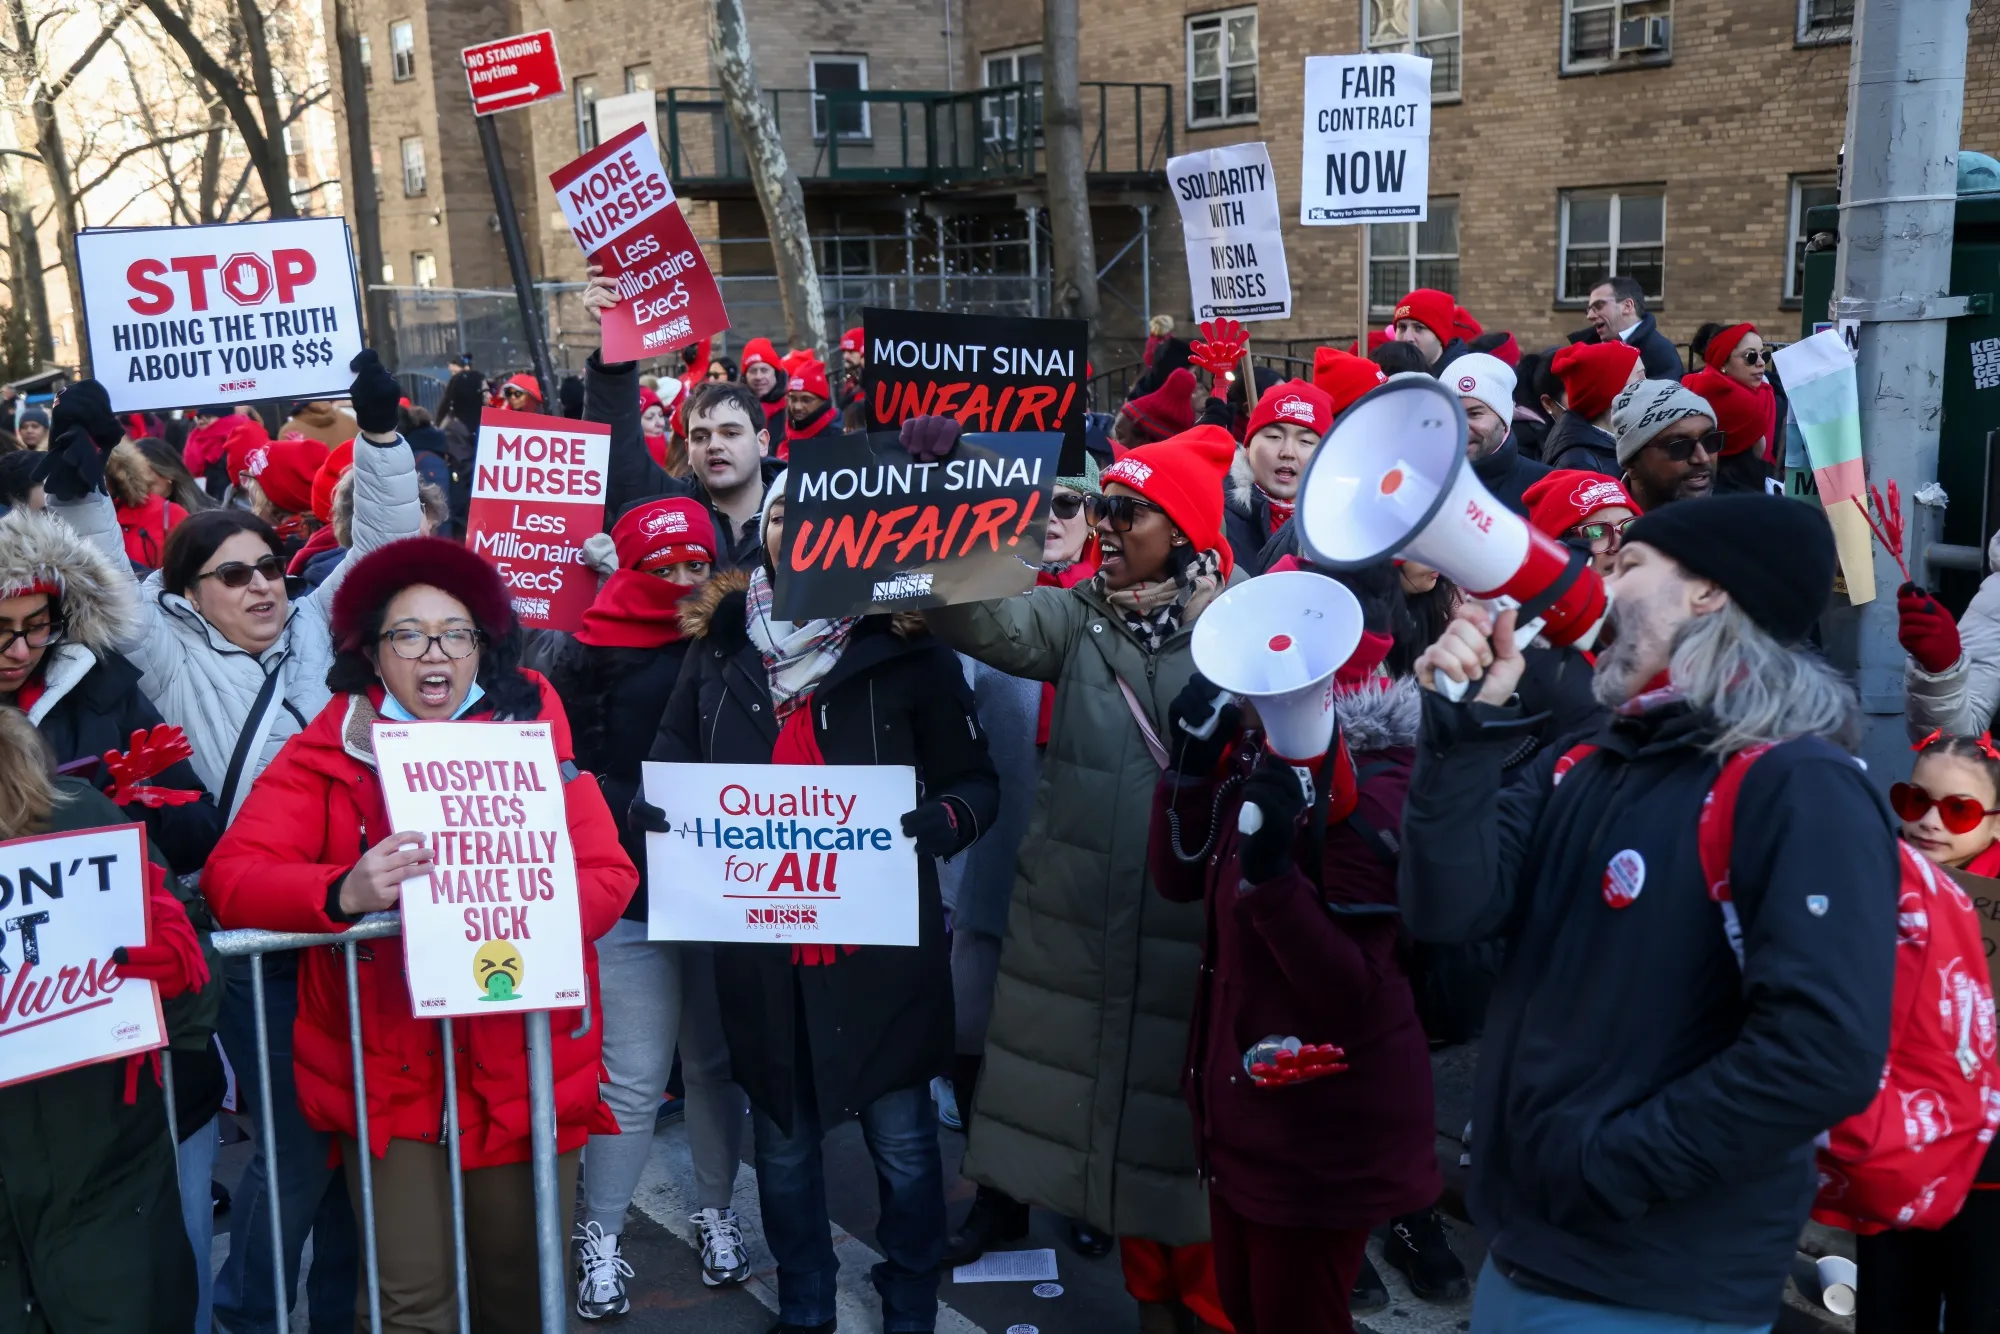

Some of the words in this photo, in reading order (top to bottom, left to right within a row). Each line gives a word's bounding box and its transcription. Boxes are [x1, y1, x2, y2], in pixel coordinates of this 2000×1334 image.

[467, 53, 484, 68] NO
[486, 40, 541, 64] STANDING
[472, 64, 518, 83] Anytime
[1341, 65, 1395, 99] FAIR
[1318, 104, 1418, 133] CONTRACT
[569, 150, 641, 216] MORE
[1177, 163, 1265, 201] SOLIDARITY
[1326, 149, 1406, 196] NOW
[572, 172, 667, 251] NURSES
[1209, 201, 1245, 227] WITH
[1353, 208, 1377, 216] Socialism
[612, 234, 660, 269] Less
[1211, 243, 1258, 270] NYSNA
[126, 248, 317, 316] STOP
[1211, 273, 1266, 300] NURSES
[632, 280, 690, 326] Exec$
[112, 318, 205, 352] HIDING
[209, 313, 256, 343] THE
[260, 306, 338, 339] TRUTH
[643, 319, 690, 346] NURSES
[644, 328, 693, 350] ASSOCIATION
[128, 350, 212, 383] ABOUT
[218, 343, 287, 375] YOUR
[292, 337, 333, 369] $$$
[873, 338, 986, 372] MOUNT
[992, 346, 1074, 377] SINAI
[219, 380, 257, 391] NURSES
[874, 380, 1076, 432] UNFAIR!
[496, 433, 586, 466] MORE
[477, 464, 601, 496] NURSES
[798, 462, 938, 503] MOUNT
[944, 457, 1042, 491] SINAI
[1580, 484, 1619, 500] NURSES
[512, 505, 566, 534] Less
[647, 513, 686, 529] NURSES
[790, 490, 1040, 572] UNFAIR!
[497, 562, 564, 593] Exec$
[873, 579, 932, 597] NURSES
[872, 588, 931, 602] ASSOCIATION
[402, 760, 547, 792] HOSPITAL
[440, 793, 527, 829] EXEC$
[719, 784, 857, 825] Quality
[695, 818, 892, 851] Healthcare
[428, 868, 512, 904] MAKE
[519, 867, 555, 902] US
[724, 854, 768, 882] for
[767, 853, 838, 892] All
[463, 905, 531, 941] SICK
[746, 909, 817, 924] NURSES
[0, 910, 50, 974] T
